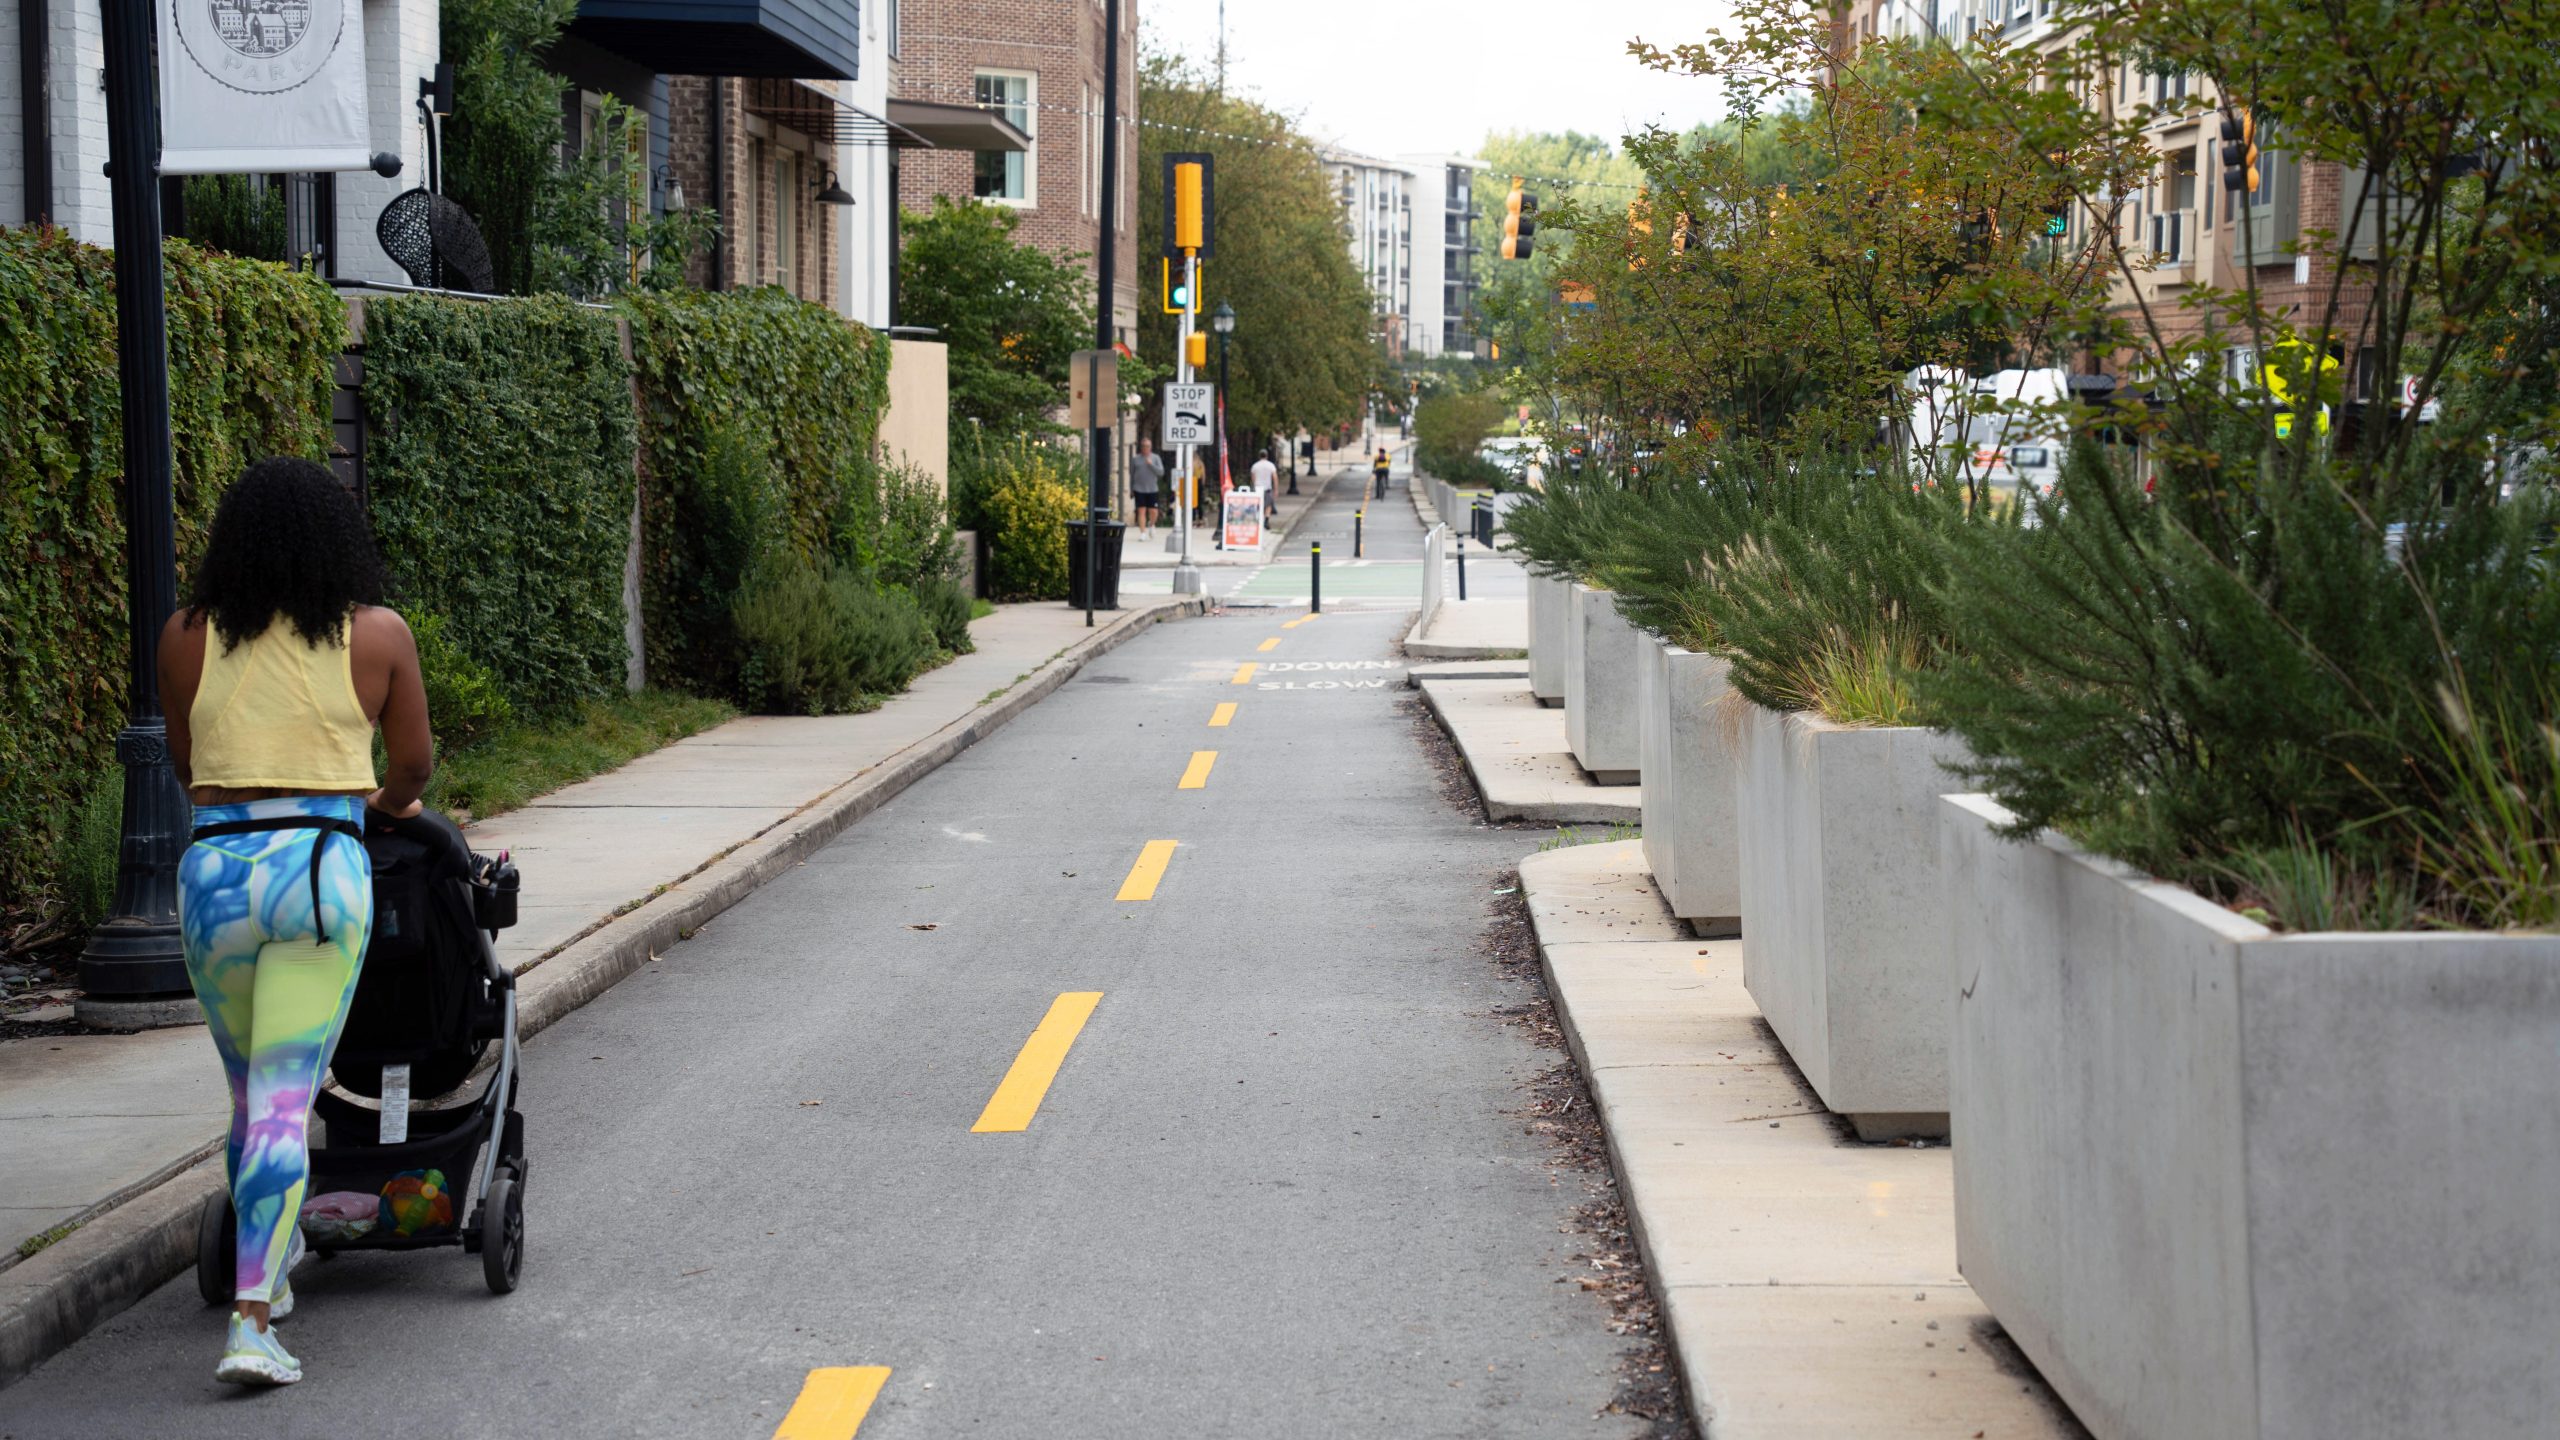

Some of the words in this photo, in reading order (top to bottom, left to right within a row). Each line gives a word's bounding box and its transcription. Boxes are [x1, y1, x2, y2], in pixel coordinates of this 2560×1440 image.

[222, 51, 311, 81] PARK
[1172, 388, 1206, 400] STOP
[1178, 401, 1199, 409] HERE
[1171, 427, 1197, 439] RED
[1268, 660, 1397, 672] DOWN
[1257, 679, 1387, 691] SLOW
